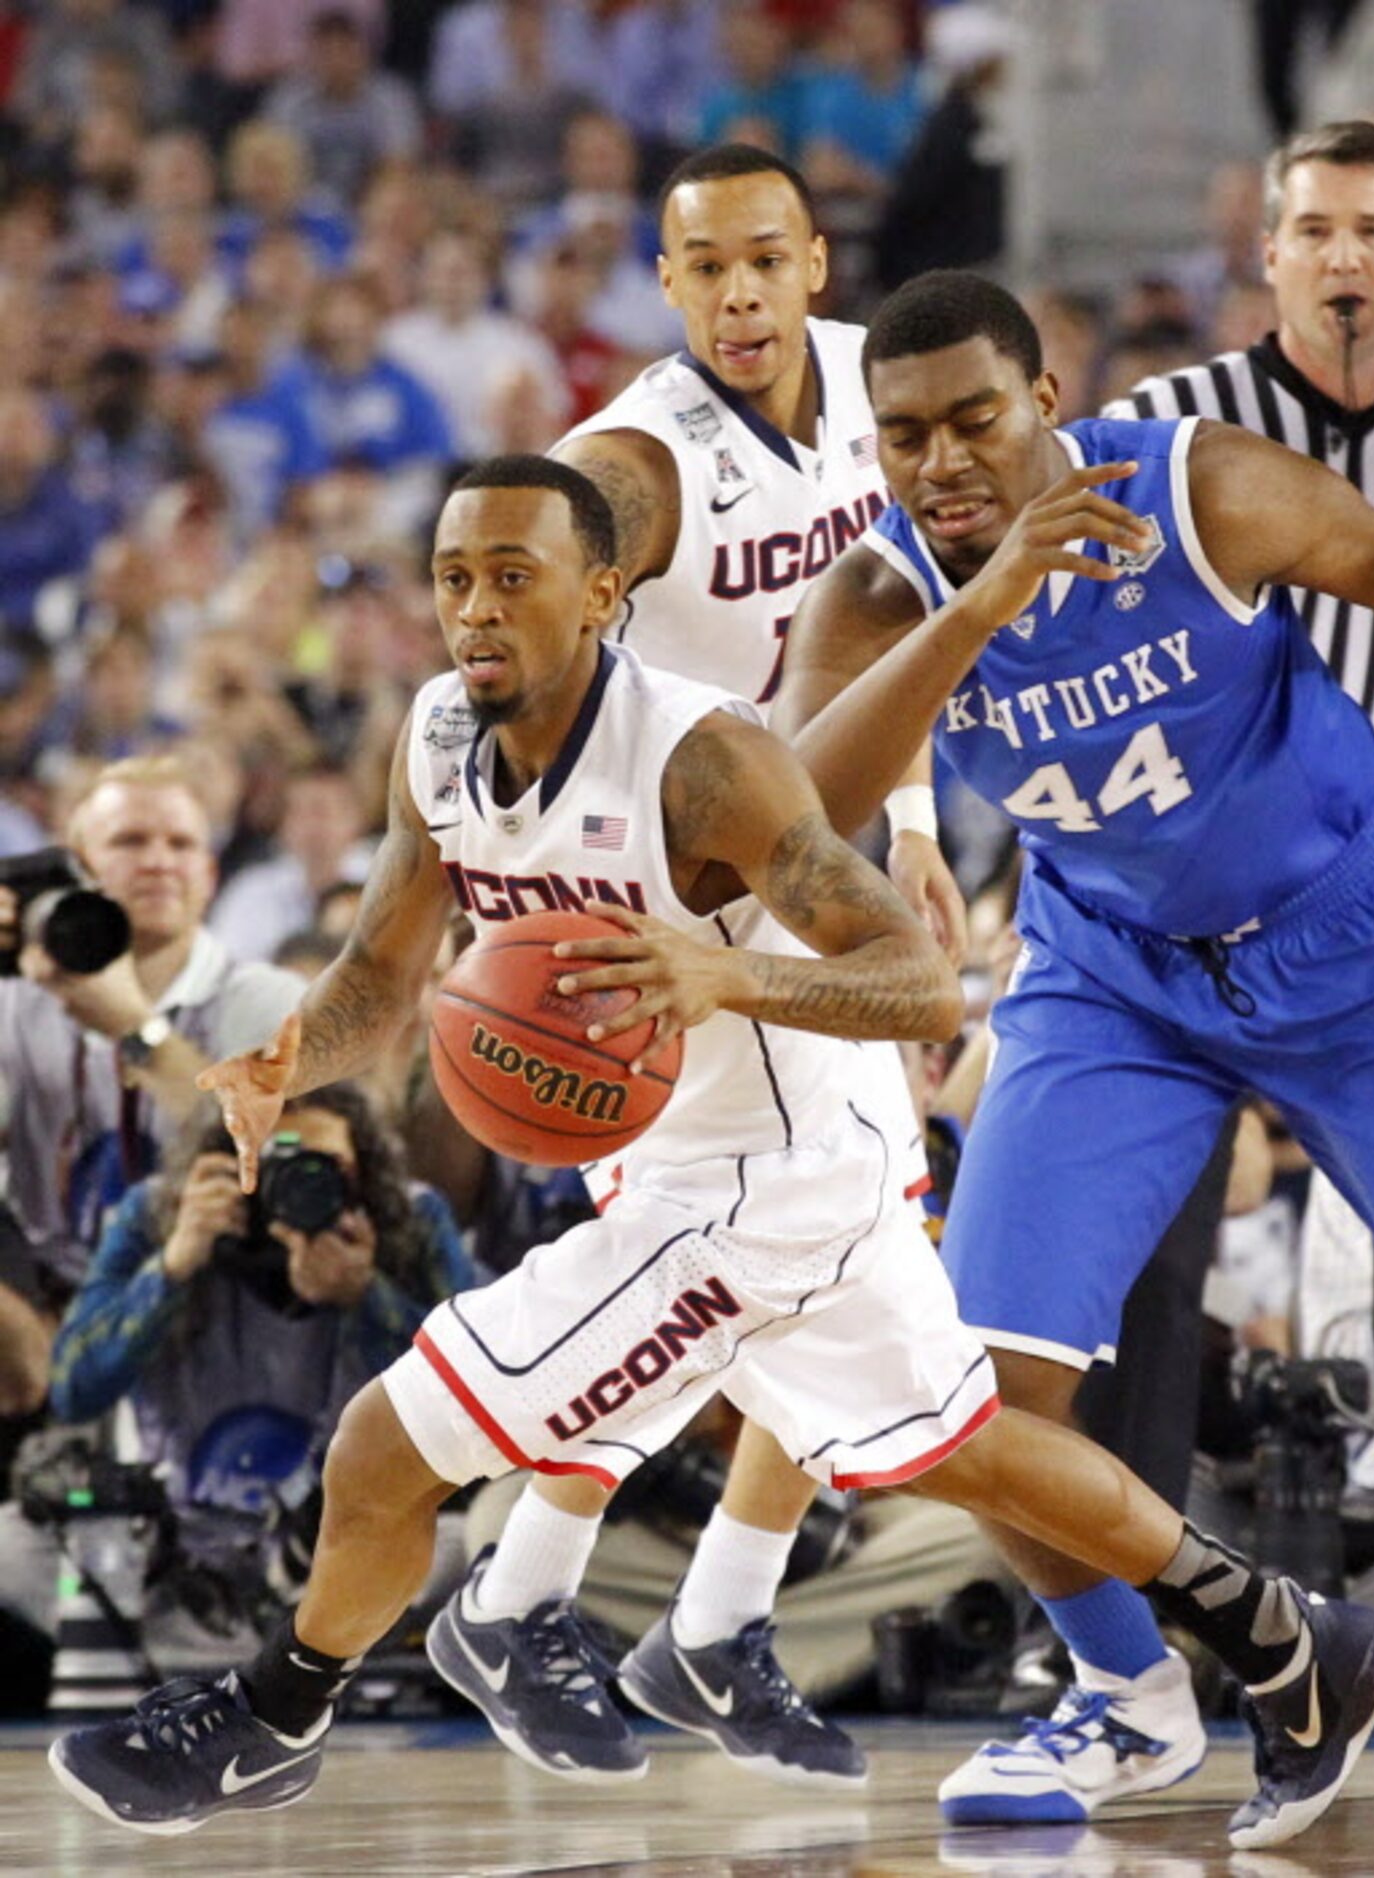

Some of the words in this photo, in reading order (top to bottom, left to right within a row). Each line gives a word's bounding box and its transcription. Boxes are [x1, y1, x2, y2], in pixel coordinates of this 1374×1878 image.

[1002, 721, 1193, 833] 44
[471, 1022, 628, 1122] Wilson
[545, 1276, 744, 1442] UCONN
